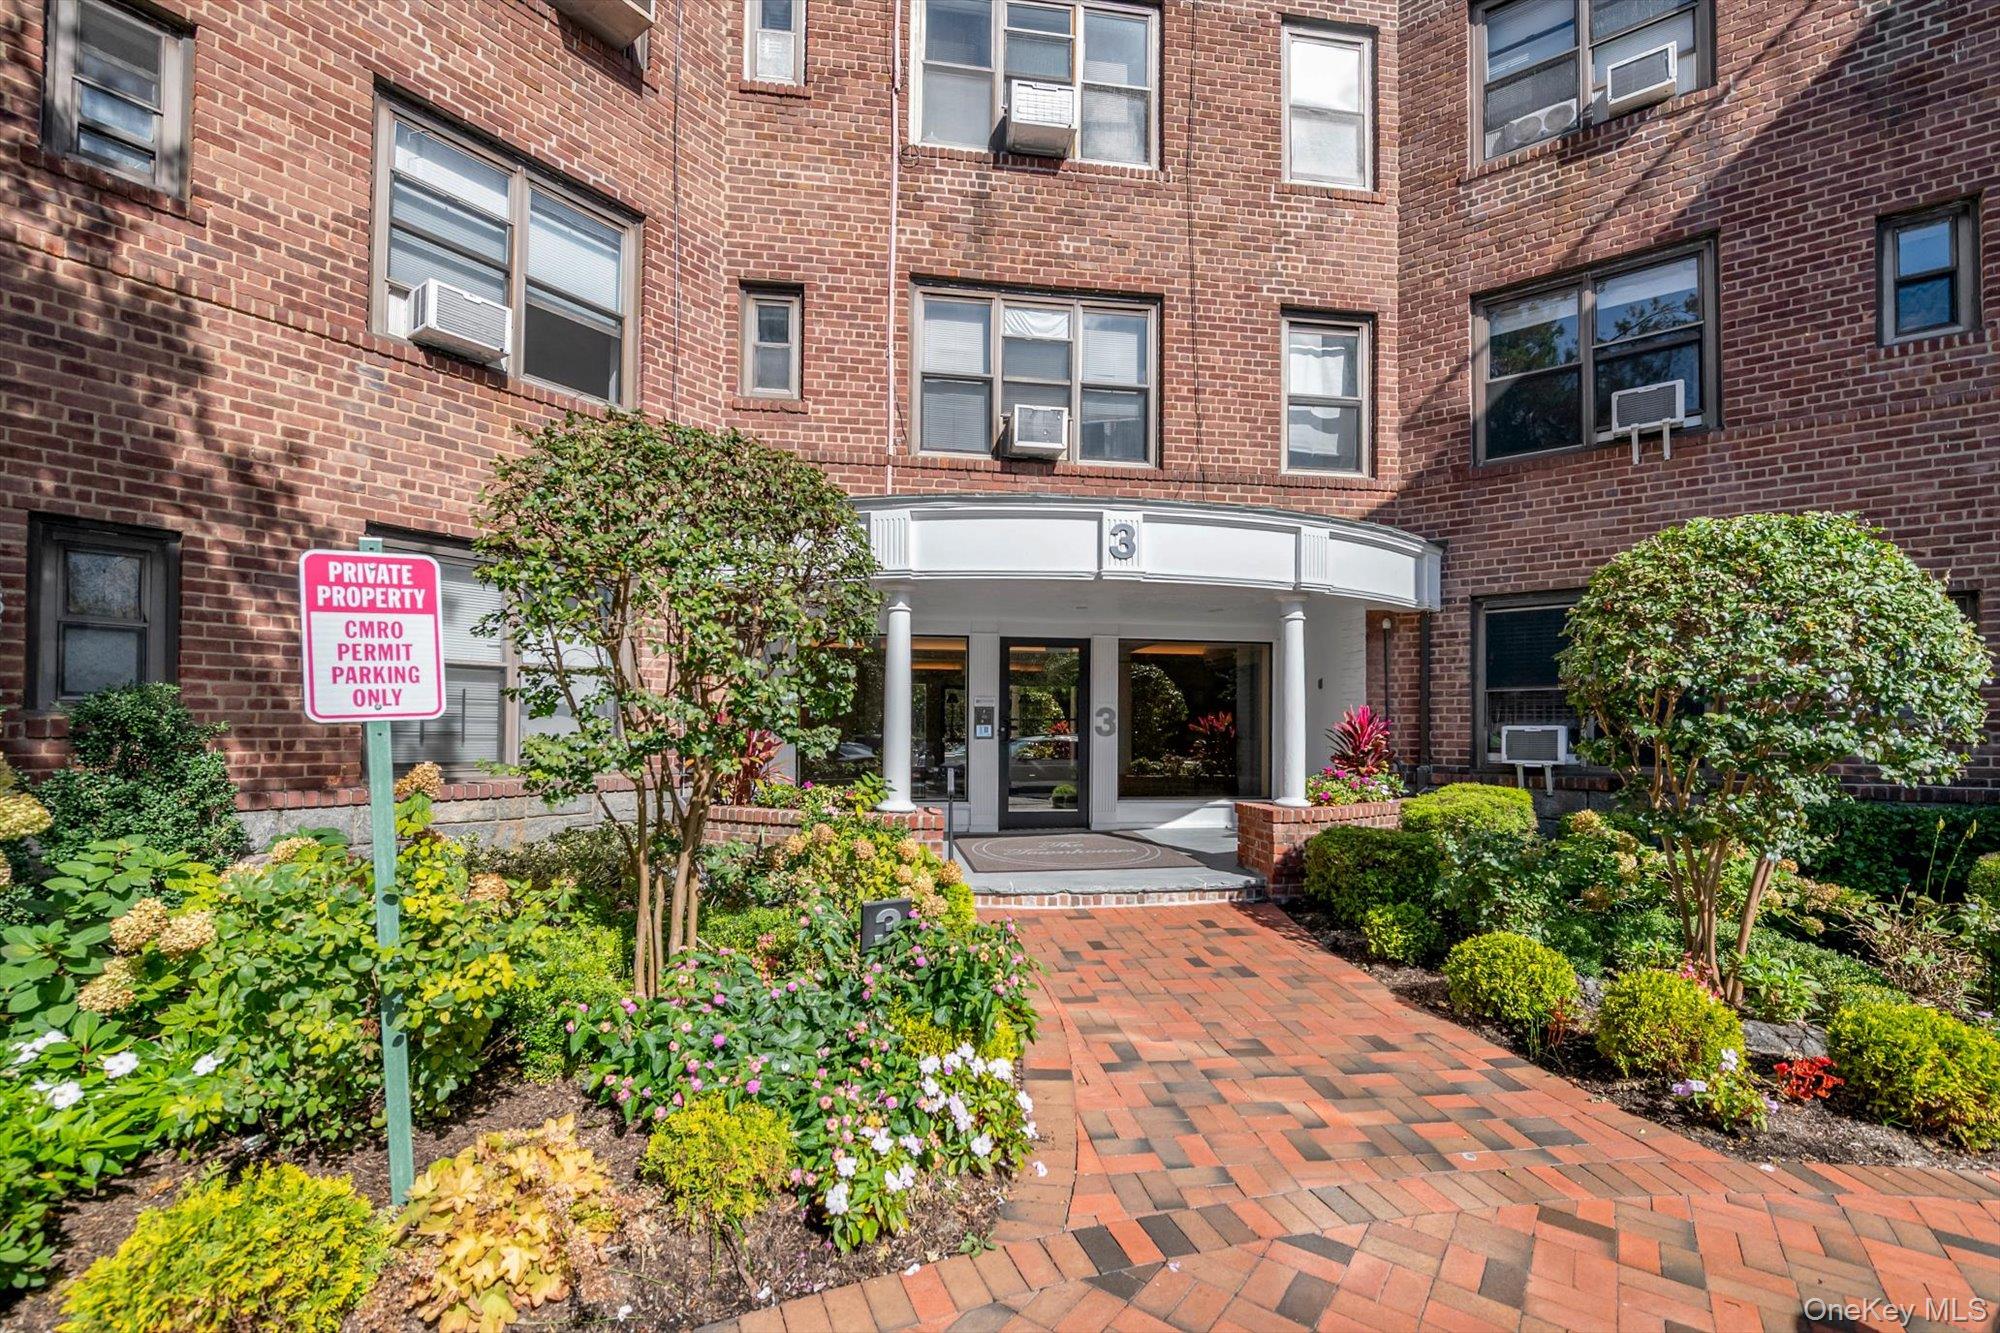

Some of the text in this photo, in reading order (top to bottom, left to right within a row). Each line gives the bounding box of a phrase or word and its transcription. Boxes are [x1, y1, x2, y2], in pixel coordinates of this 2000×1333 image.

[1109, 523, 1136, 560] 3
[328, 561, 414, 585] PRIVATE
[316, 585, 426, 609] PROPERTY
[344, 620, 404, 639] CMRO
[337, 643, 413, 661] PERMIT
[331, 666, 421, 684] PARKING
[352, 688, 402, 707] ONLY
[1095, 707, 1117, 737] 3
